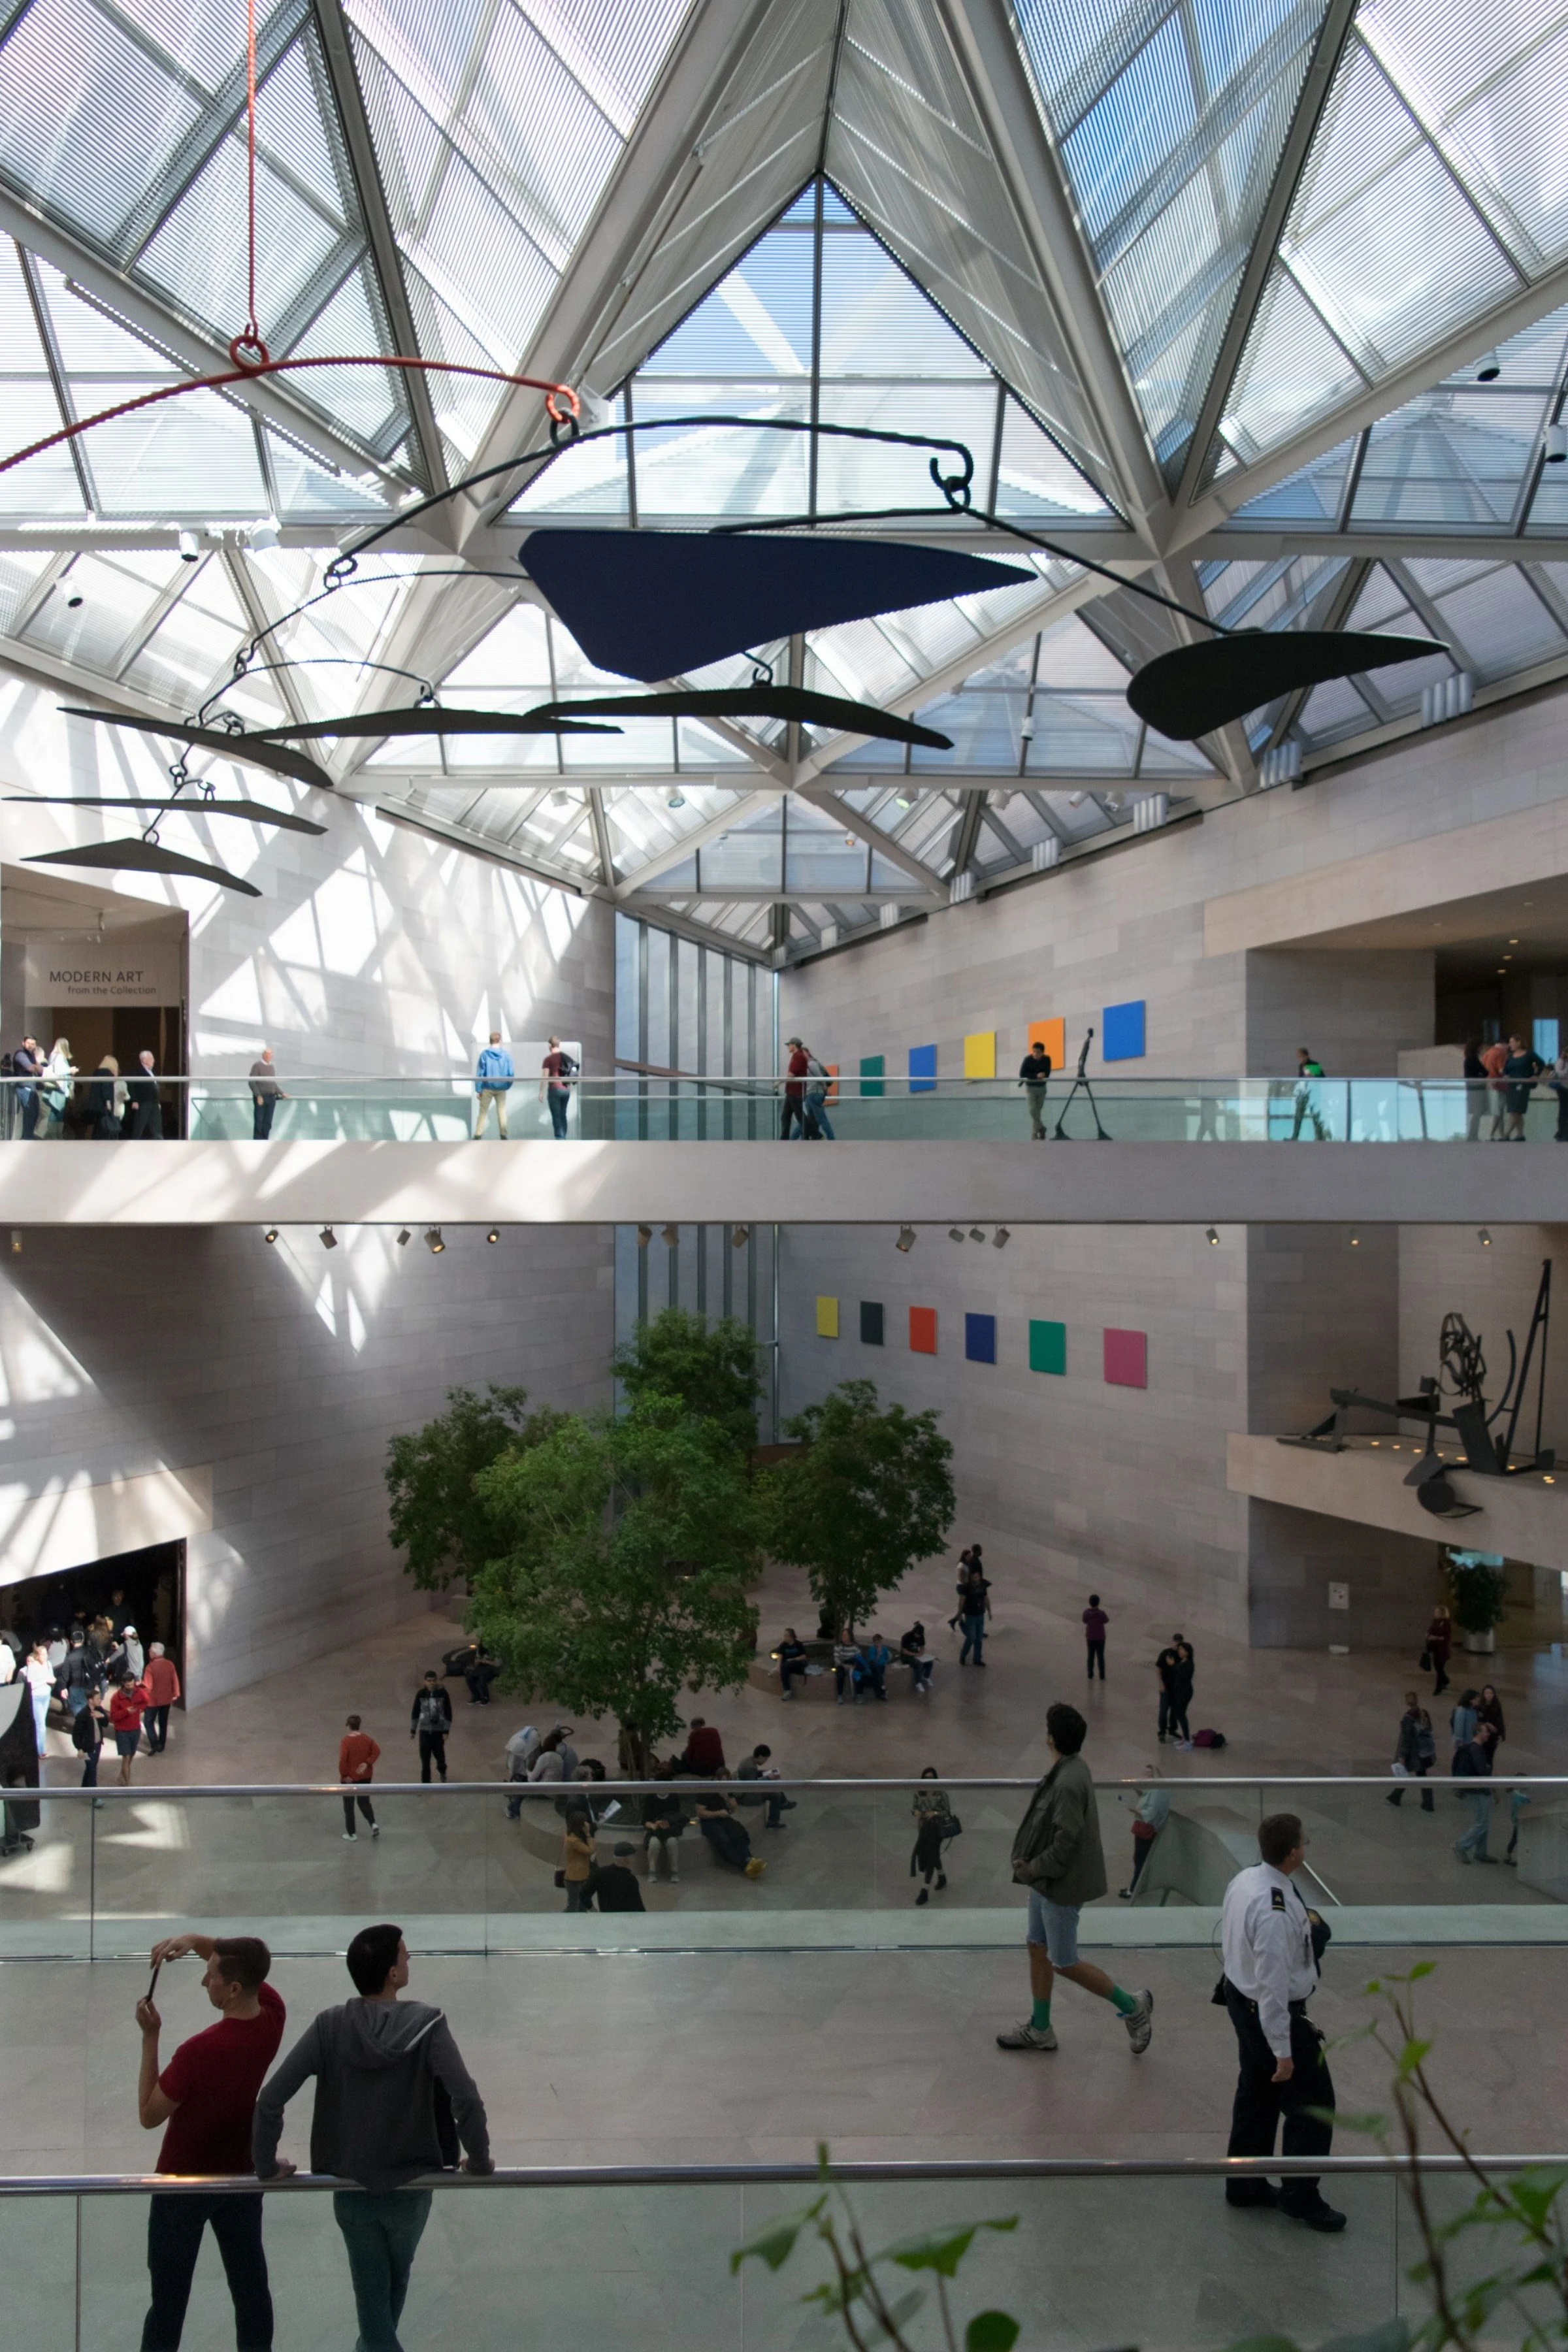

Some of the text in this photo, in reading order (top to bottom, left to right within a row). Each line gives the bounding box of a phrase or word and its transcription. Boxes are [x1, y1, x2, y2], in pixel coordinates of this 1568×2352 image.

[49, 971, 144, 983] MODERN ART
[68, 985, 157, 995] from the Collection
